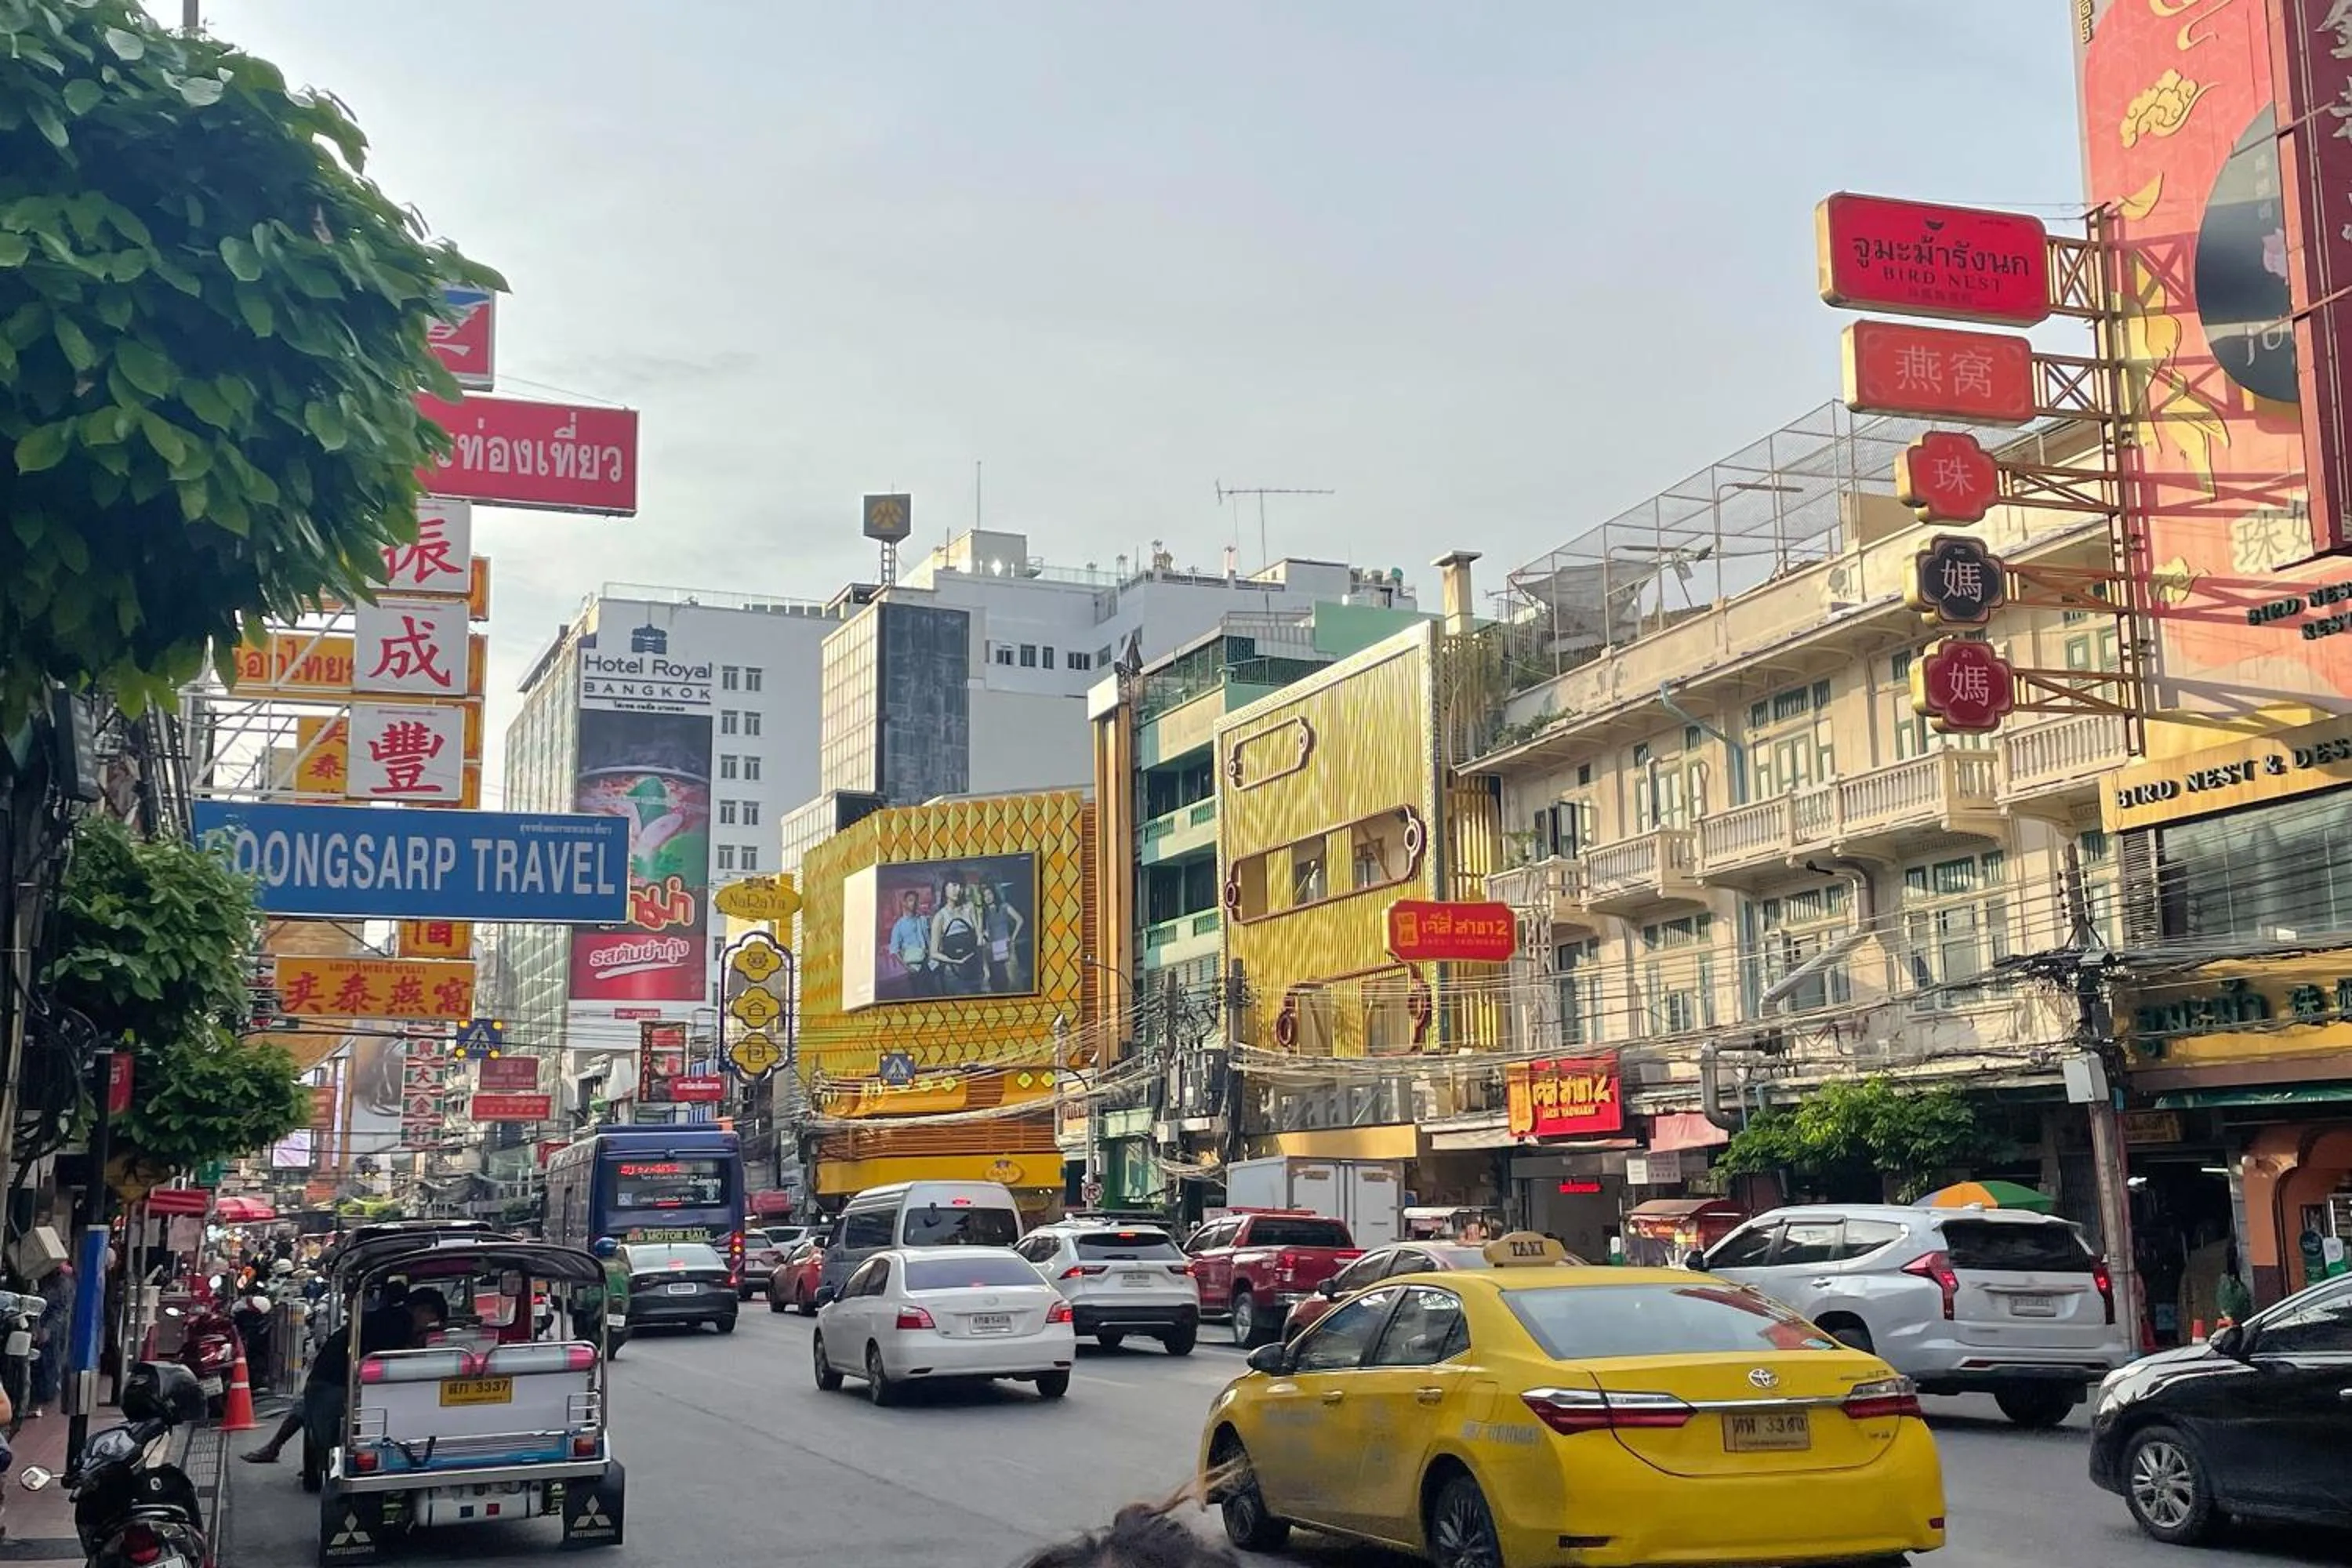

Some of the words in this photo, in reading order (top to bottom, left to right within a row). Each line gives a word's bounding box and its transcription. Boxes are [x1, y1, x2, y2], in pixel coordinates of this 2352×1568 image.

[1884, 265, 1936, 285] BIRD
[1948, 274, 2002, 294] NEST
[1932, 456, 1974, 498] 珠
[1940, 557, 1984, 603] 媽
[2248, 598, 2300, 626] BIRD
[368, 615, 451, 688] 成
[584, 654, 643, 673] Hotel
[652, 659, 713, 682] Royal
[584, 681, 711, 700] BANGKOK
[1948, 662, 1990, 707] 媽
[2117, 779, 2180, 808] BIRD
[2185, 759, 2258, 793] NEST
[2263, 753, 2286, 775] &
[471, 838, 615, 894] TRAVEL
[1496, 920, 1508, 935] 2
[647, 1230, 684, 1241] MOTOR
[1509, 1240, 1546, 1257] TAXI
